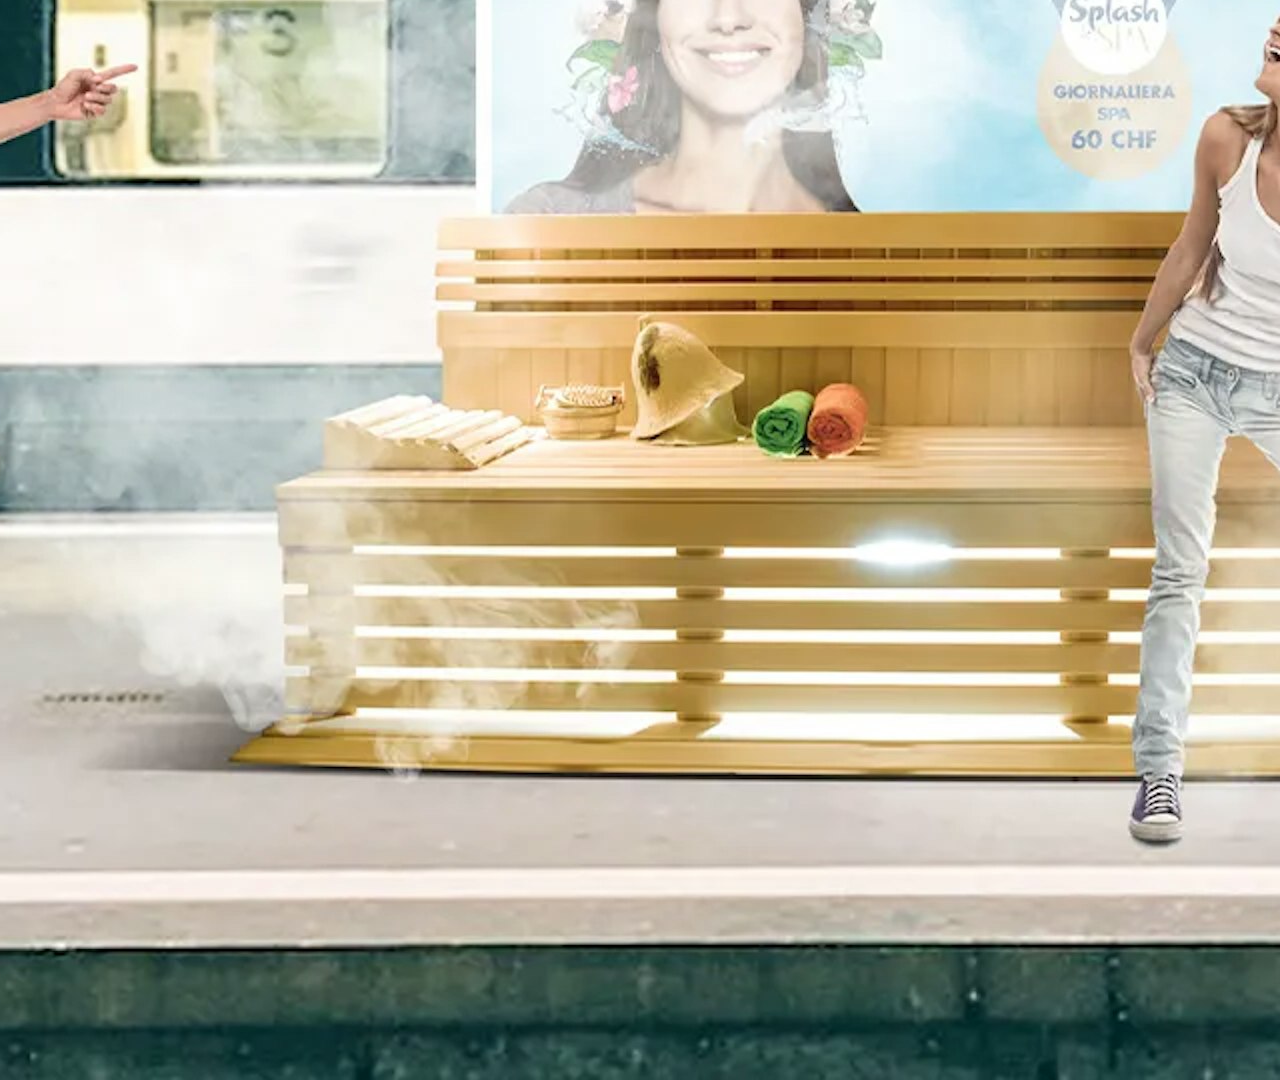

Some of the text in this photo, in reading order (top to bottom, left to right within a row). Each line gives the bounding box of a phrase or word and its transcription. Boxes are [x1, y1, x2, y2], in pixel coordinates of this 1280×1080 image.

[1053, 84, 1176, 100] GIORNALIERA
[1097, 106, 1132, 121] SPA
[1071, 129, 1157, 149] 60 CHF
